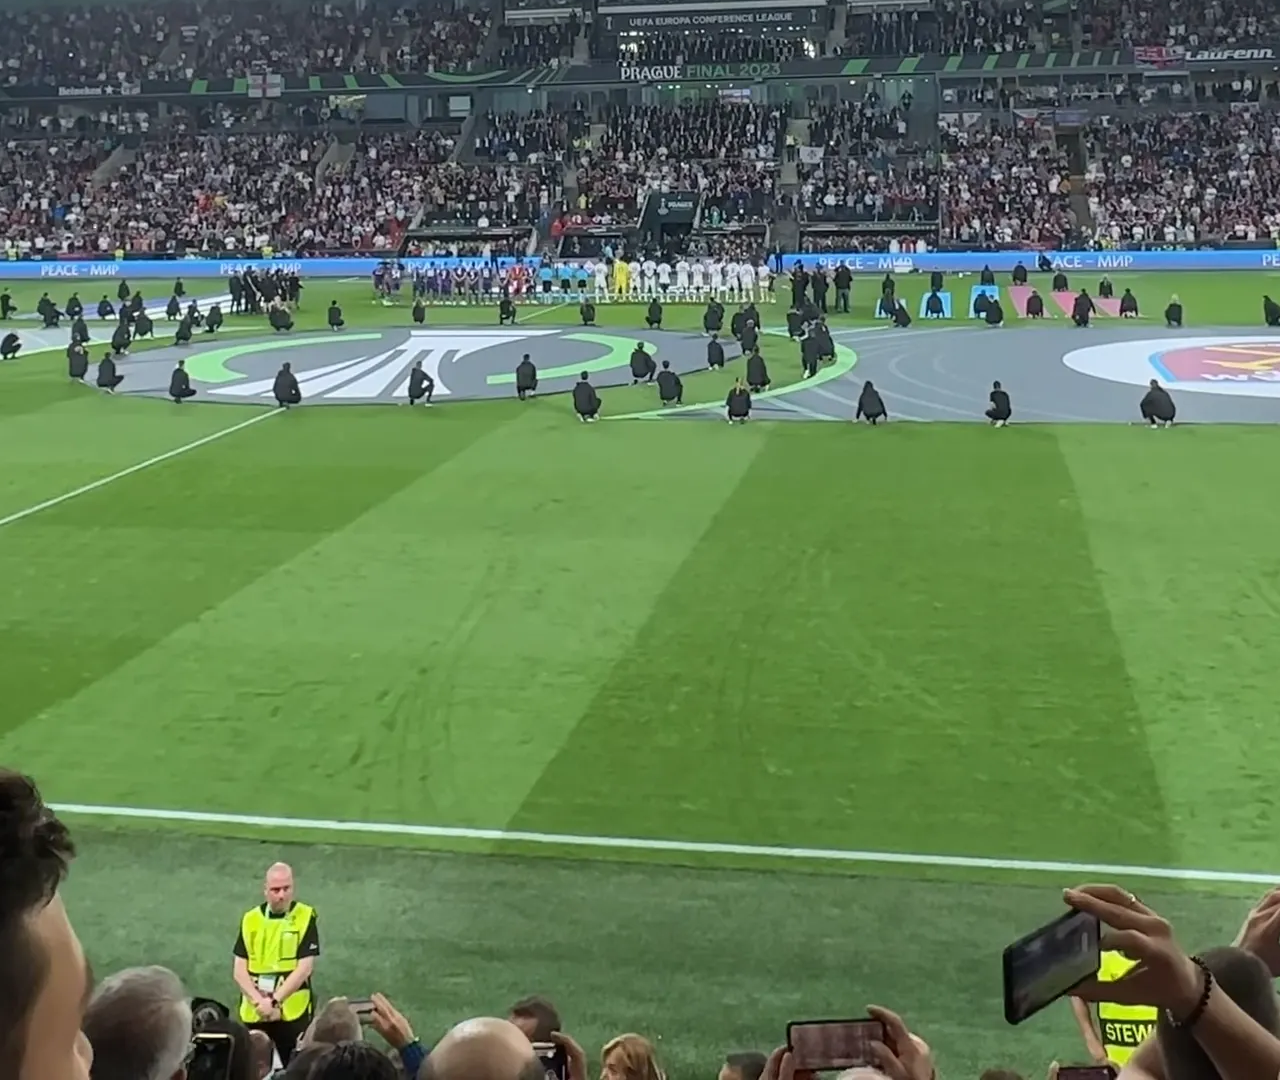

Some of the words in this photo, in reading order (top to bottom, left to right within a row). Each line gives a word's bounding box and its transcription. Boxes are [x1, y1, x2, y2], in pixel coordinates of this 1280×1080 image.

[629, 18, 654, 27] UEFA
[655, 16, 691, 26] EUROPA
[692, 14, 754, 25] CONFERENCE
[755, 12, 793, 23] LEAGUE
[620, 65, 683, 80] PRAGUE
[686, 64, 735, 78] FINAL
[739, 63, 781, 77] 2023
[1035, 255, 1082, 268] ACE
[1097, 255, 1133, 268] МИР
[41, 264, 78, 276] PEACE
[1105, 1022, 1156, 1043] STEW
